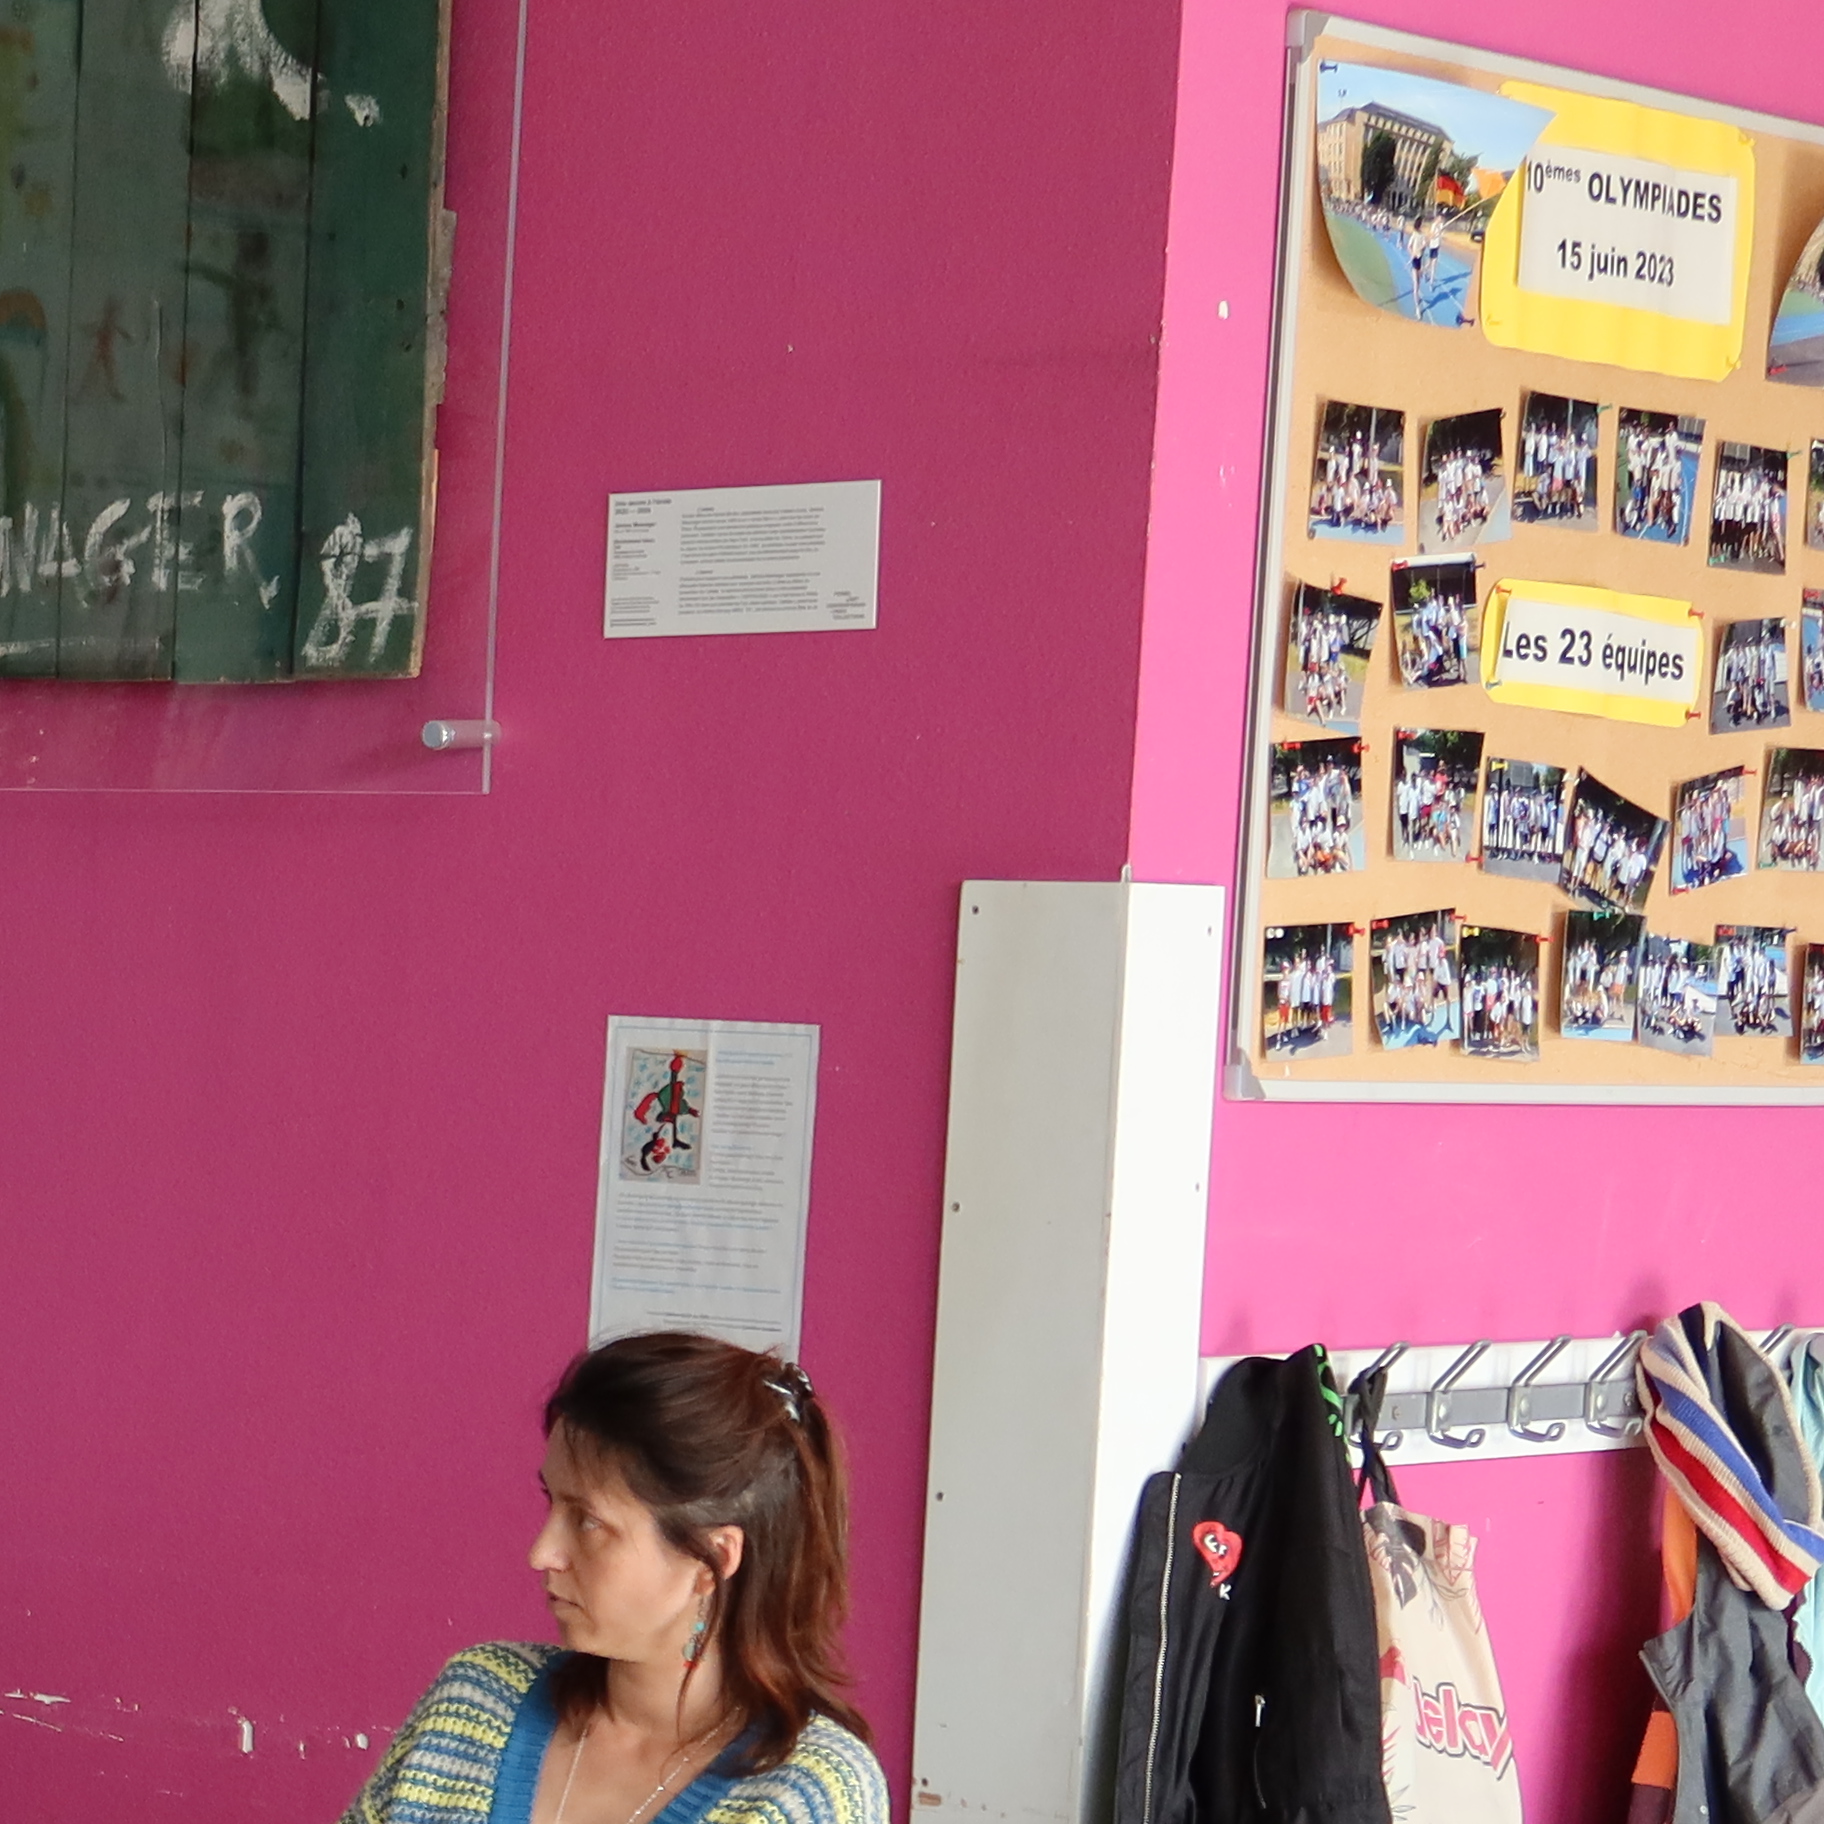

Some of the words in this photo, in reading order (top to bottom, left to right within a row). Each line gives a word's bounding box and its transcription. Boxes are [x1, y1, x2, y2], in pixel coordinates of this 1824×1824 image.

[1587, 171, 1723, 224] OLYMPIADES
[1556, 239, 1583, 272] 15
[1588, 241, 1629, 282] juin
[1635, 251, 1675, 288] 2023
[301, 511, 418, 667] 87
[1500, 619, 1549, 663] Les
[1558, 628, 1594, 669] 23
[1601, 631, 1684, 685] équipes
